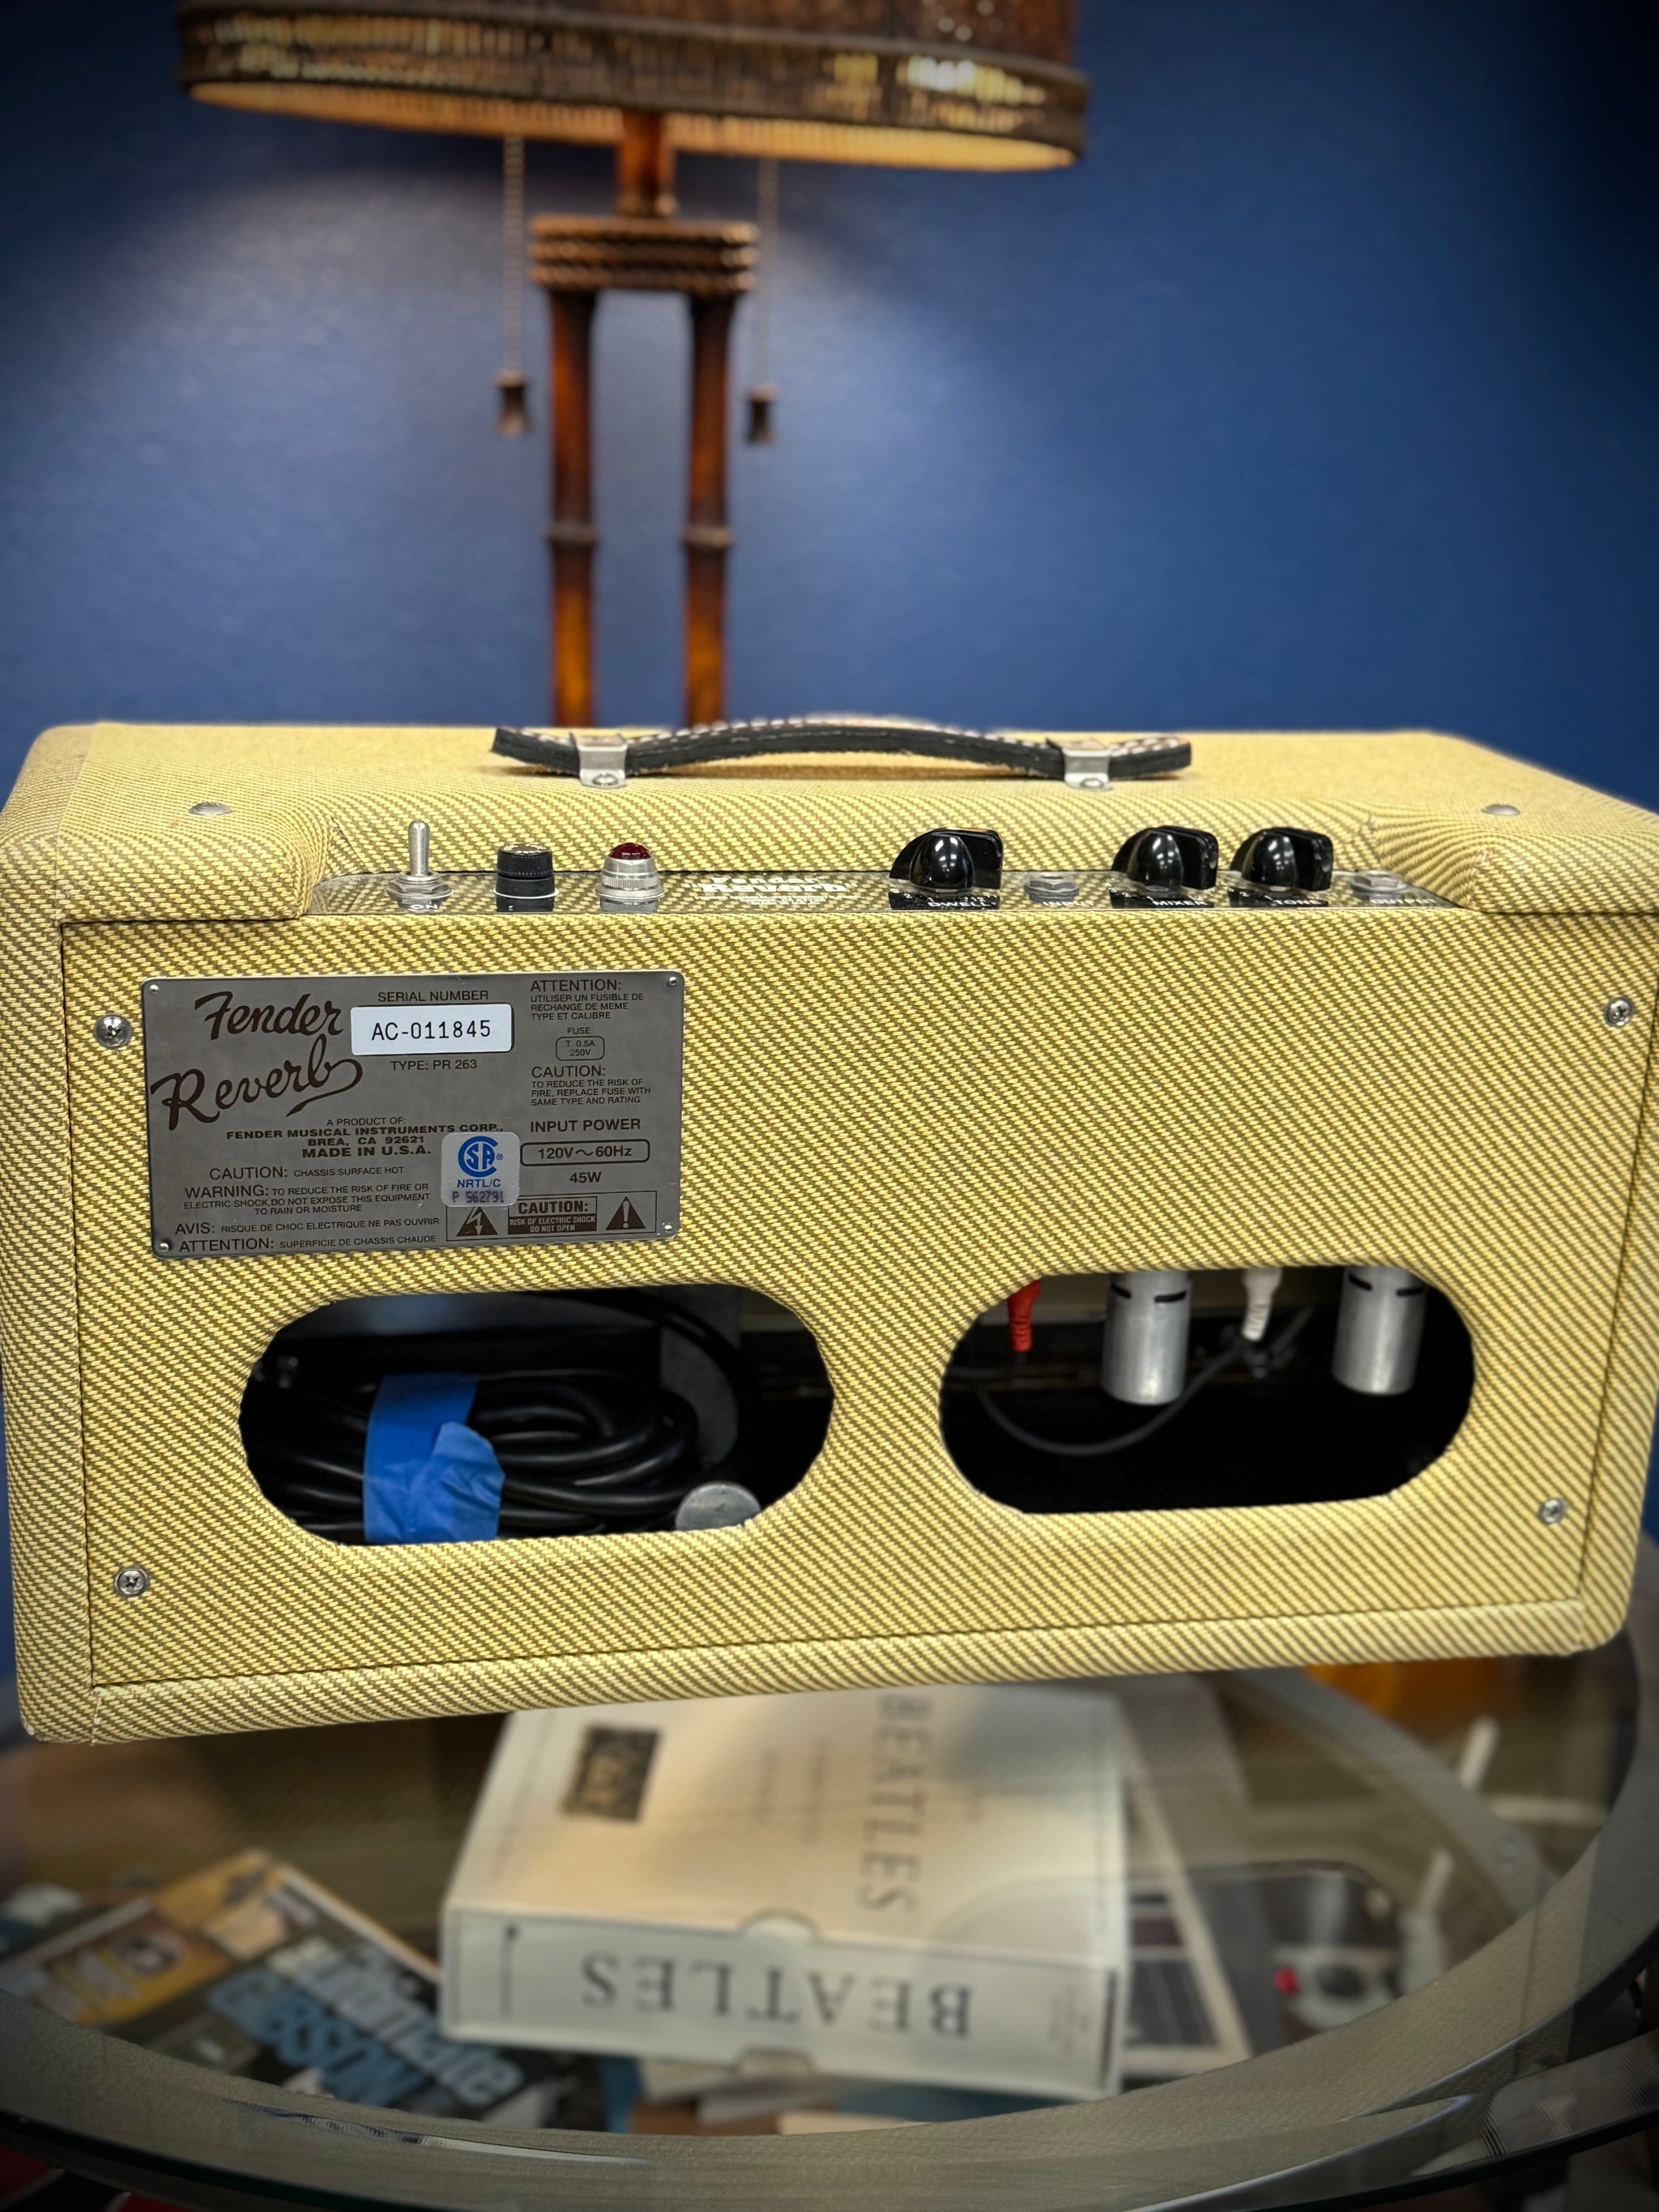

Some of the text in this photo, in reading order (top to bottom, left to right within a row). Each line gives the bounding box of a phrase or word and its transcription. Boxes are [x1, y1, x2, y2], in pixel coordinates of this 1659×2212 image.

[711, 876, 821, 884] Fender
[531, 978, 621, 992] ATTENTION:
[377, 990, 488, 1003] SERIAL NUMBER
[531, 994, 572, 1003] UTILISER
[574, 994, 588, 1002] UN
[591, 993, 629, 1001] FUSIBLE
[531, 1004, 582, 1012] RECHANGE
[585, 1003, 598, 1011] DE
[194, 991, 343, 1040] Fender
[571, 1012, 611, 1020] CALIBRE
[371, 1020, 491, 1041] AC-011845
[390, 1059, 477, 1071] TYPE: PR 263
[531, 1065, 606, 1078] CAUTION:
[150, 1034, 363, 1132] Reverb
[547, 1080, 585, 1088] REDUCE
[531, 1089, 554, 1097] FIRE,
[557, 1089, 599, 1097] REPLACE
[531, 1098, 557, 1106] SAME
[608, 1096, 641, 1104] RATING
[336, 1117, 387, 1126] PRODUCT
[531, 1118, 641, 1133] INPUT POWER
[226, 1130, 283, 1140] FENDER
[287, 1128, 351, 1138] MUSICAL
[355, 1125, 455, 1135] INSTRUMENTS
[308, 1136, 424, 1147] BREA, CA 92621
[302, 1144, 432, 1158] MADE IN U.S.A.
[209, 1166, 405, 1180] CAUTION: CHASSIS SURFACE HOT
[569, 1171, 602, 1183] 45W
[457, 1178, 501, 1188] NRTL/C
[185, 1185, 269, 1199] WARNING:
[288, 1187, 327, 1196] REDUCE
[331, 1186, 348, 1194] THE
[351, 1185, 373, 1193] RISK
[376, 1184, 389, 1192] OF
[391, 1183, 412, 1191] FIRE
[452, 1191, 459, 1203] P
[184, 1200, 231, 1209] ELECTRIC
[288, 1197, 308, 1205] NOT
[310, 1196, 348, 1204] EXPOSE
[352, 1196, 373, 1204] THIS
[375, 1193, 430, 1203] EQUIPMENT
[518, 1200, 589, 1215] CAUTION:
[254, 1204, 362, 1216] TO RAIN OR MOISTURE
[175, 1222, 215, 1235] AVIS:
[221, 1225, 257, 1233] RISQUE
[260, 1224, 273, 1232] DE
[275, 1223, 304, 1231] CHOC
[306, 1220, 365, 1230] ELECTRIQUE
[383, 1219, 401, 1227] PAS
[403, 1217, 440, 1225] OUVRIR
[510, 1216, 595, 1226] RISK OF ELECTRIC SHOCK
[557, 1224, 575, 1232] OPEN
[179, 1235, 437, 1252] ATTENTION: SUPERFICIE DE CHASSIS CHAUDE
[855, 1693, 932, 1913] BEATLES
[581, 1950, 972, 2038] BEATLES
